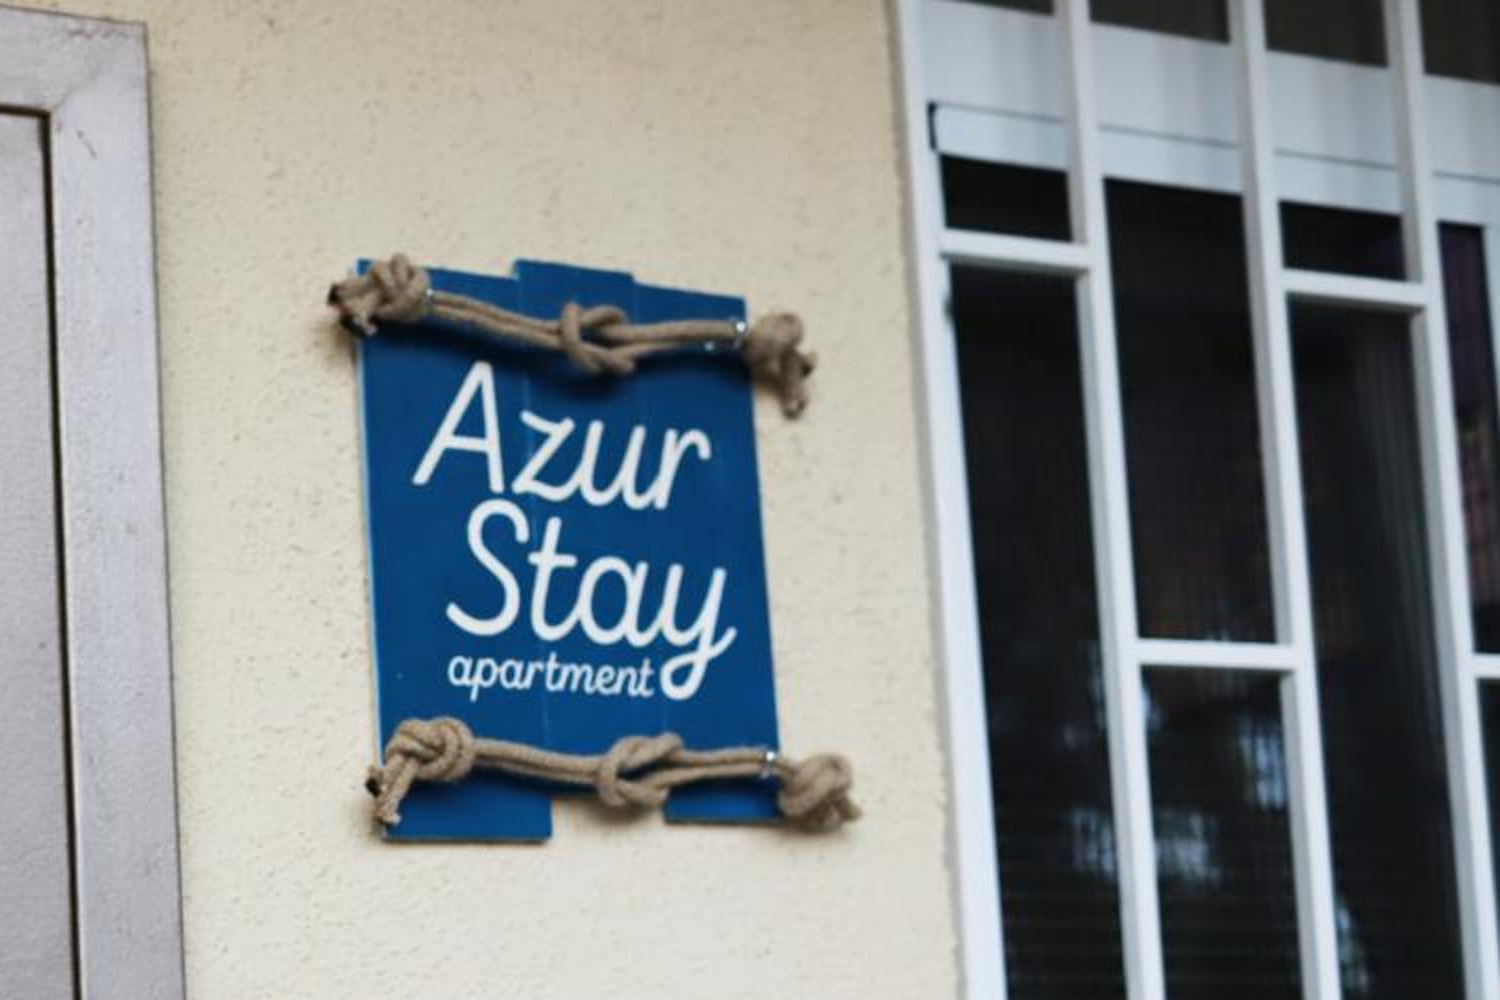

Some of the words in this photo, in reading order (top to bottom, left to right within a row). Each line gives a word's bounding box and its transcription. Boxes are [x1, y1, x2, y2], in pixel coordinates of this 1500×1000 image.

[412, 361, 711, 511] Azur
[446, 498, 737, 700] Stay
[447, 651, 655, 702] apartment
